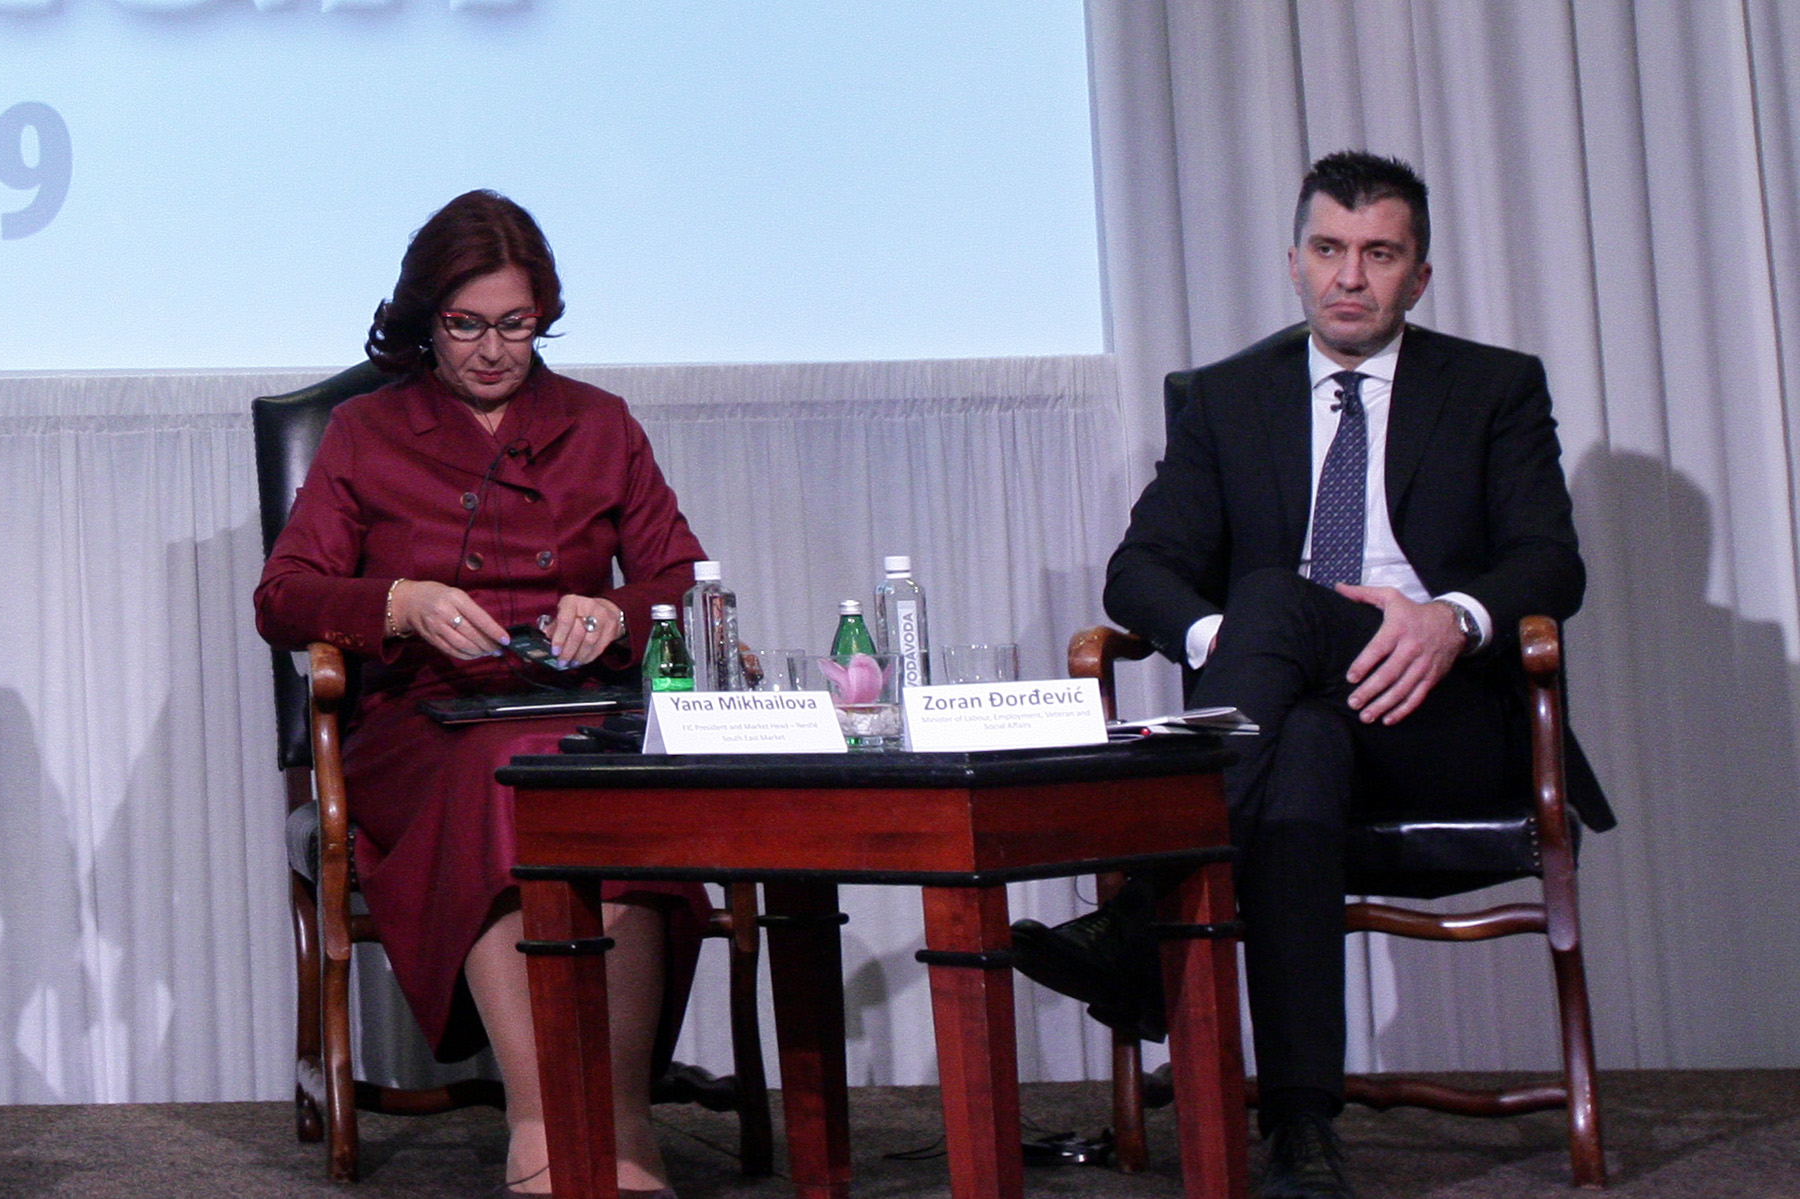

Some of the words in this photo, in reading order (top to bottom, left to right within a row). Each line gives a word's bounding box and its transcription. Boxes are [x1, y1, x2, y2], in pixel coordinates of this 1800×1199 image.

[669, 696, 714, 712] Yana
[718, 695, 818, 711] Mikhailova
[922, 695, 983, 711] Zoran
[988, 686, 1085, 708] Đorđević
